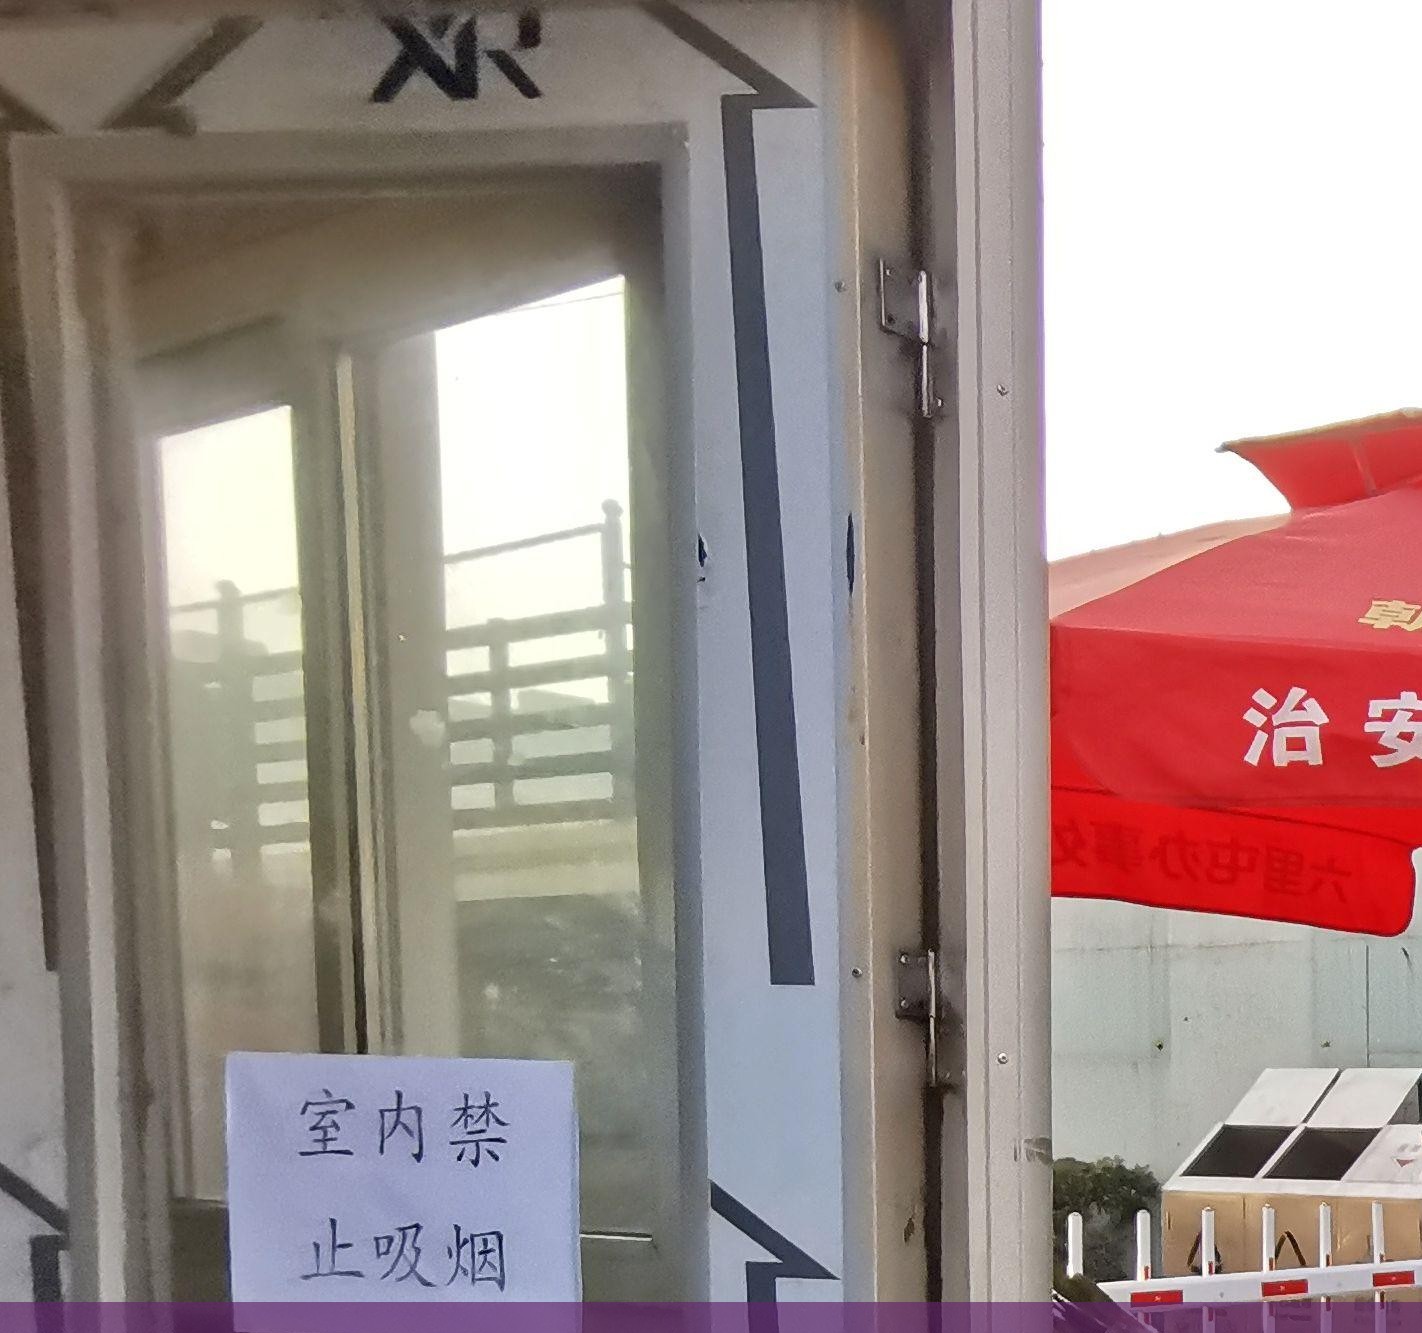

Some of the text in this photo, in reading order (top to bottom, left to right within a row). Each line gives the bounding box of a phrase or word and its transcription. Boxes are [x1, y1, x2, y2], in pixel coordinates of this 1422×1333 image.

[298, 1089, 510, 1168] 室内禁
[299, 1217, 507, 1292] 止吸烟
